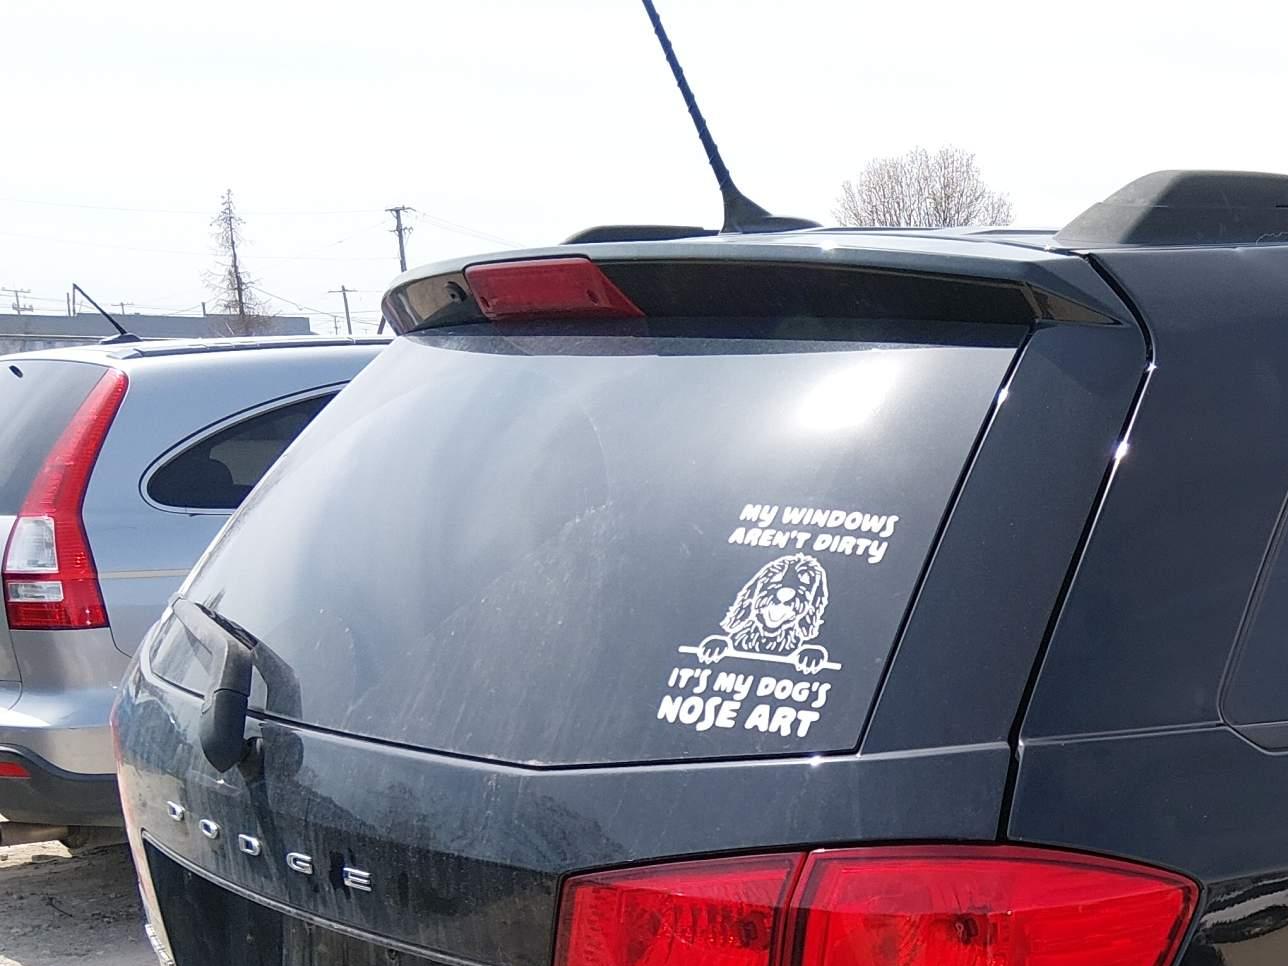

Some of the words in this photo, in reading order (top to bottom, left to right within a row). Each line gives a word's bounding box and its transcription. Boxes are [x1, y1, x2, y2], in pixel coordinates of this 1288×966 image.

[739, 504, 779, 527] MY
[782, 506, 899, 537] WINDOWS
[728, 527, 812, 548] AREN'T
[813, 534, 888, 564] DIRTY
[668, 667, 711, 694] IT'S
[713, 672, 754, 701] MY
[756, 677, 831, 708] DOG'S
[657, 695, 741, 731] NOSE
[744, 704, 820, 737] ART
[167, 801, 372, 892] DODGE
